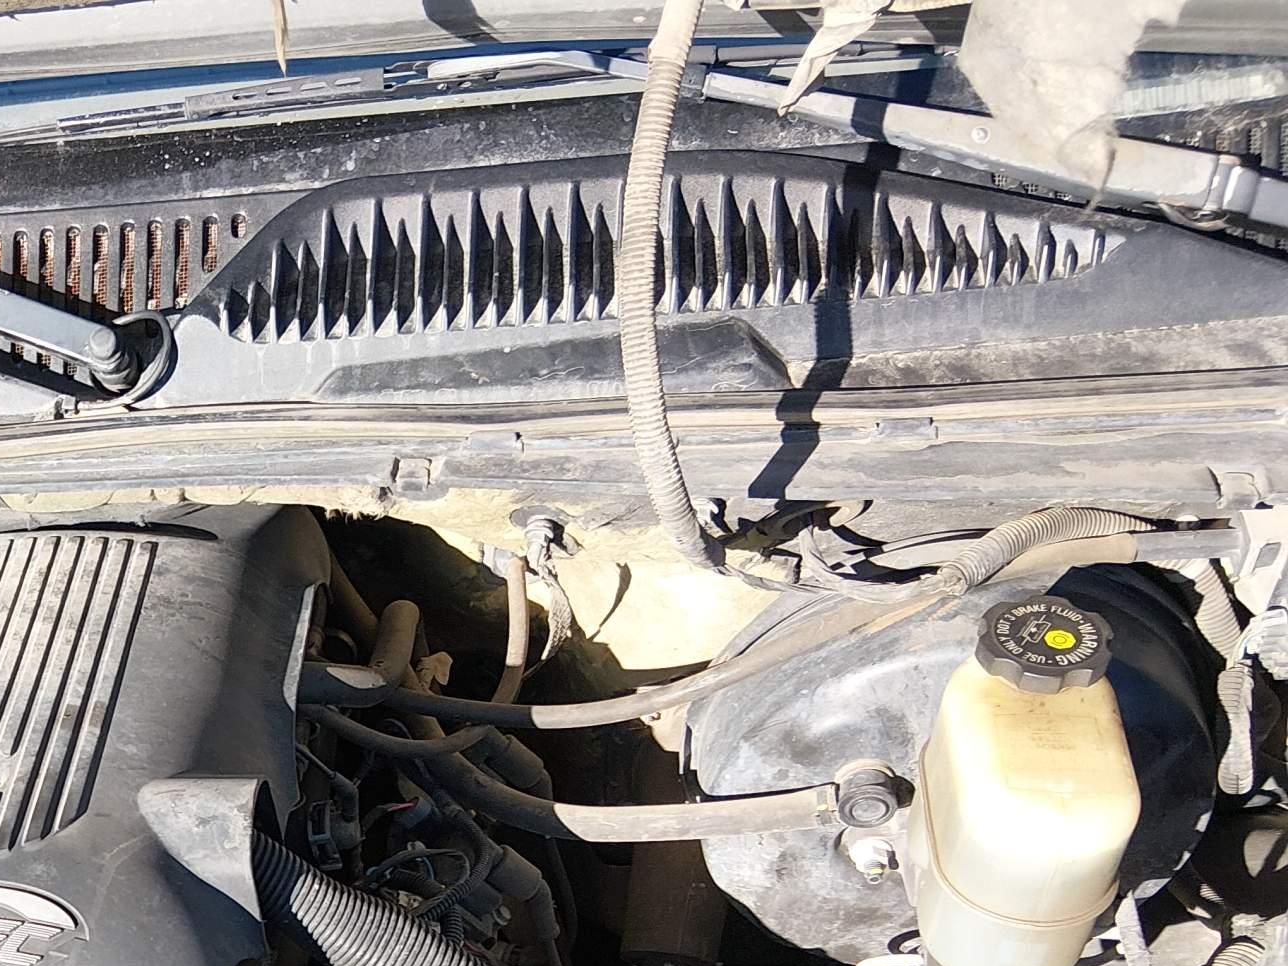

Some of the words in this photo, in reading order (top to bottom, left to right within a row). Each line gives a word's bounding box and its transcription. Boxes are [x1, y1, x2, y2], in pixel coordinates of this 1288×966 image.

[1012, 603, 1047, 617] BRAKE
[1050, 605, 1082, 622] FLUID
[996, 619, 1011, 635] DOT
[999, 637, 1024, 656] ONLY
[1056, 622, 1099, 666] WARNING
[1023, 652, 1046, 664] USE
